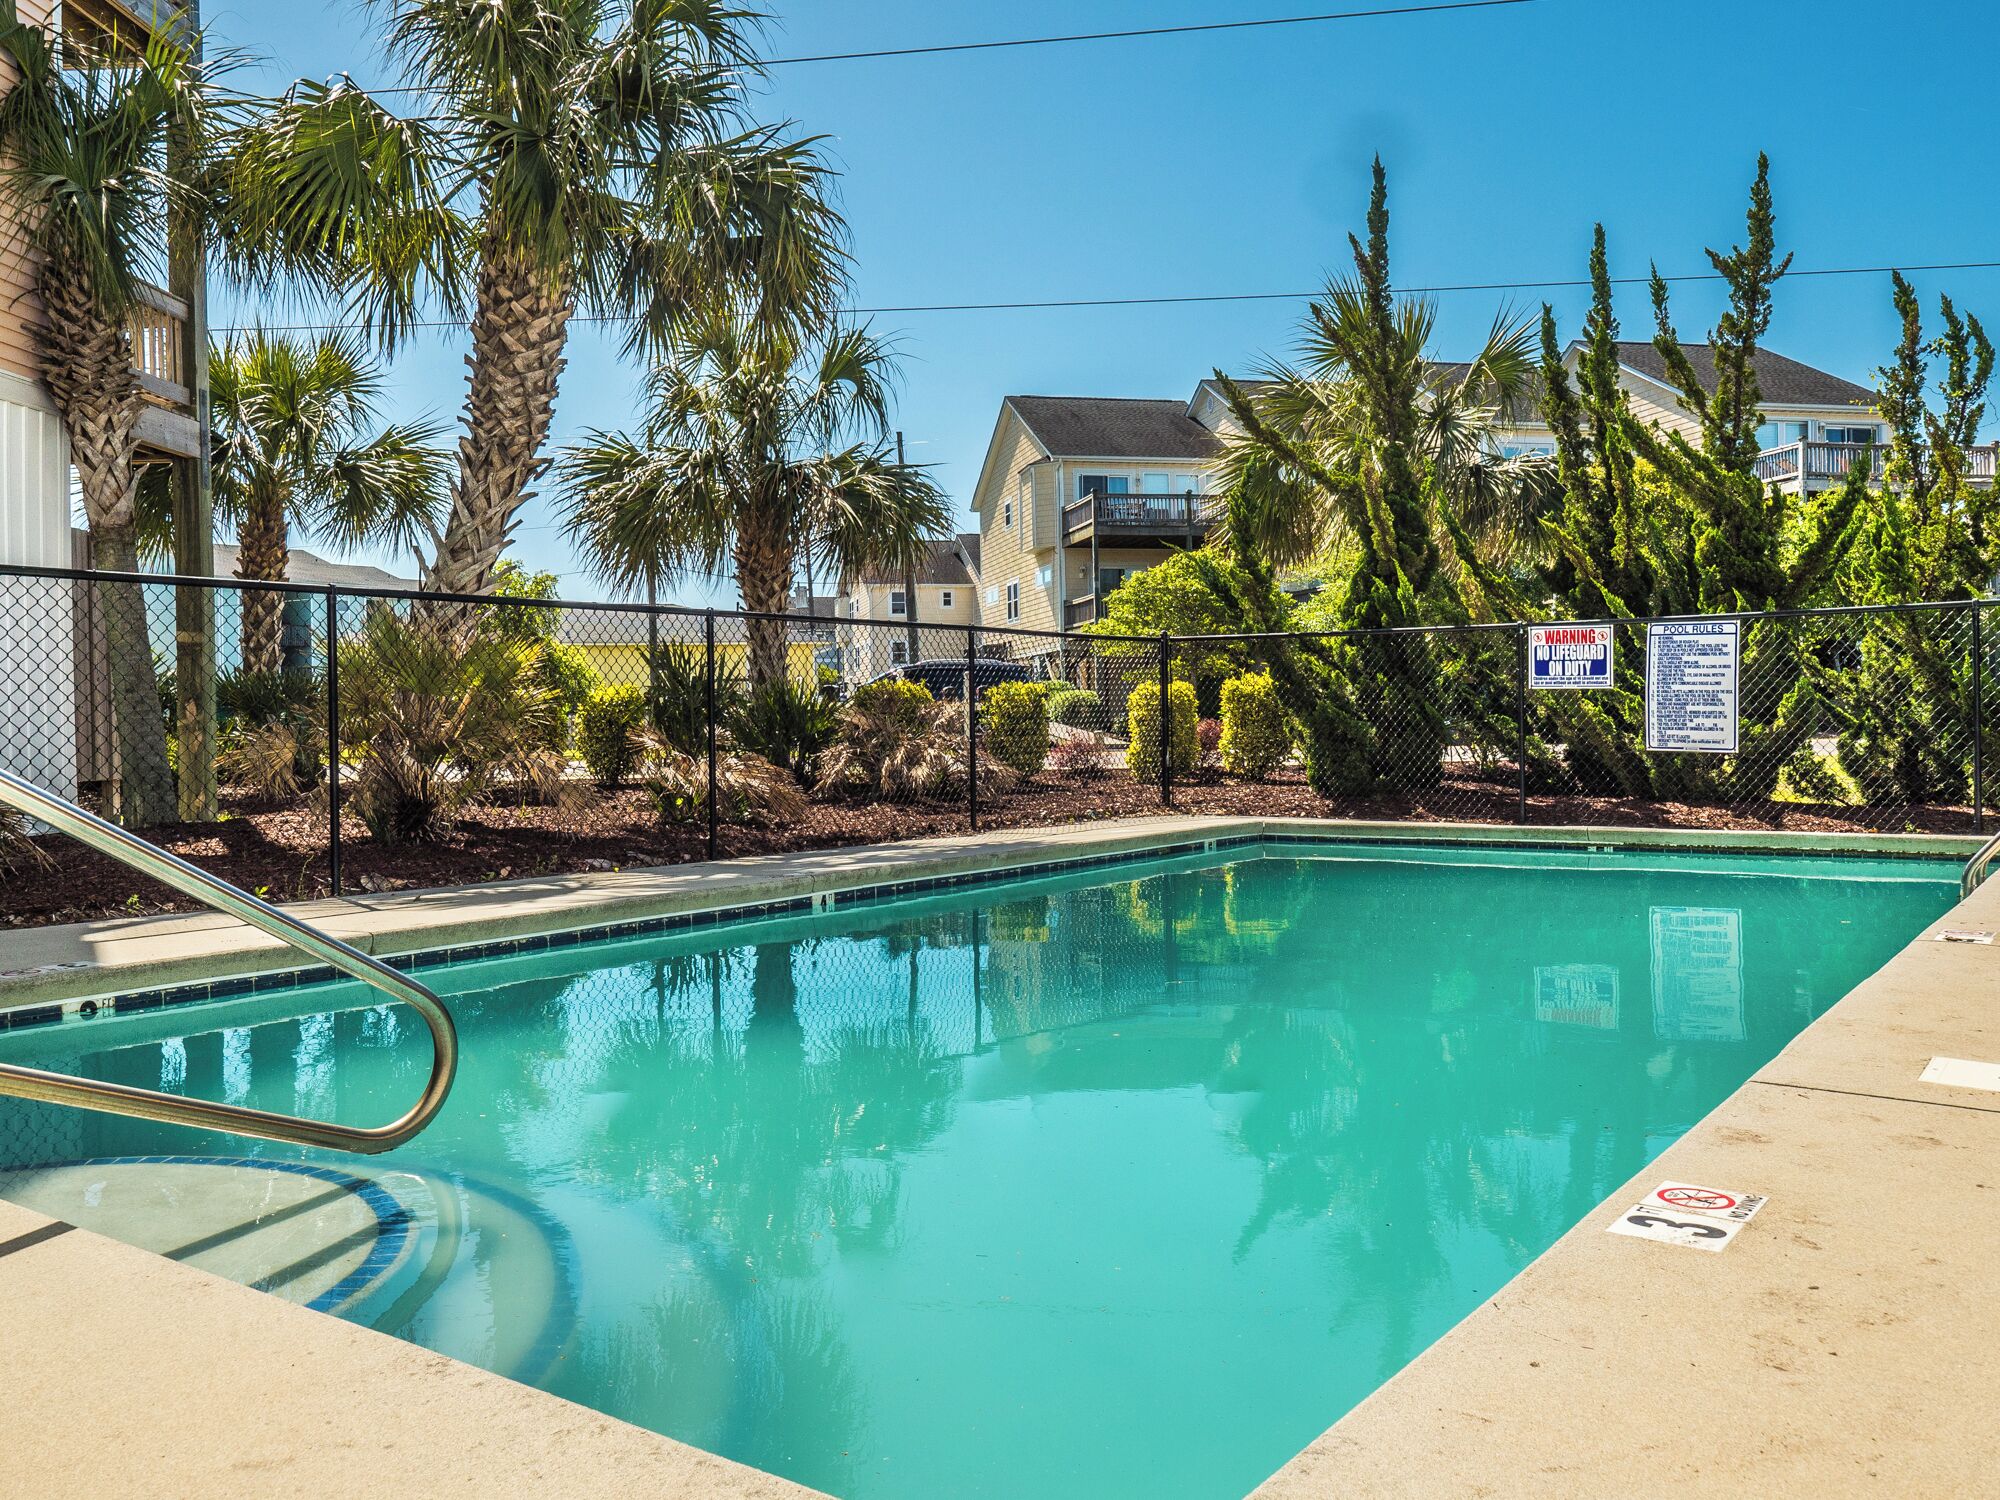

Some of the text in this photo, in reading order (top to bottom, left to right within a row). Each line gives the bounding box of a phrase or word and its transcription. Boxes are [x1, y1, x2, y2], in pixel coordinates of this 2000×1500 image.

[1544, 629, 1596, 644] WARNING
[1692, 625, 1724, 633] RULES
[1536, 644, 1604, 660] NO LIFEGUARD
[1548, 660, 1592, 676] ON DUTY
[1626, 1215, 1728, 1238] 3
